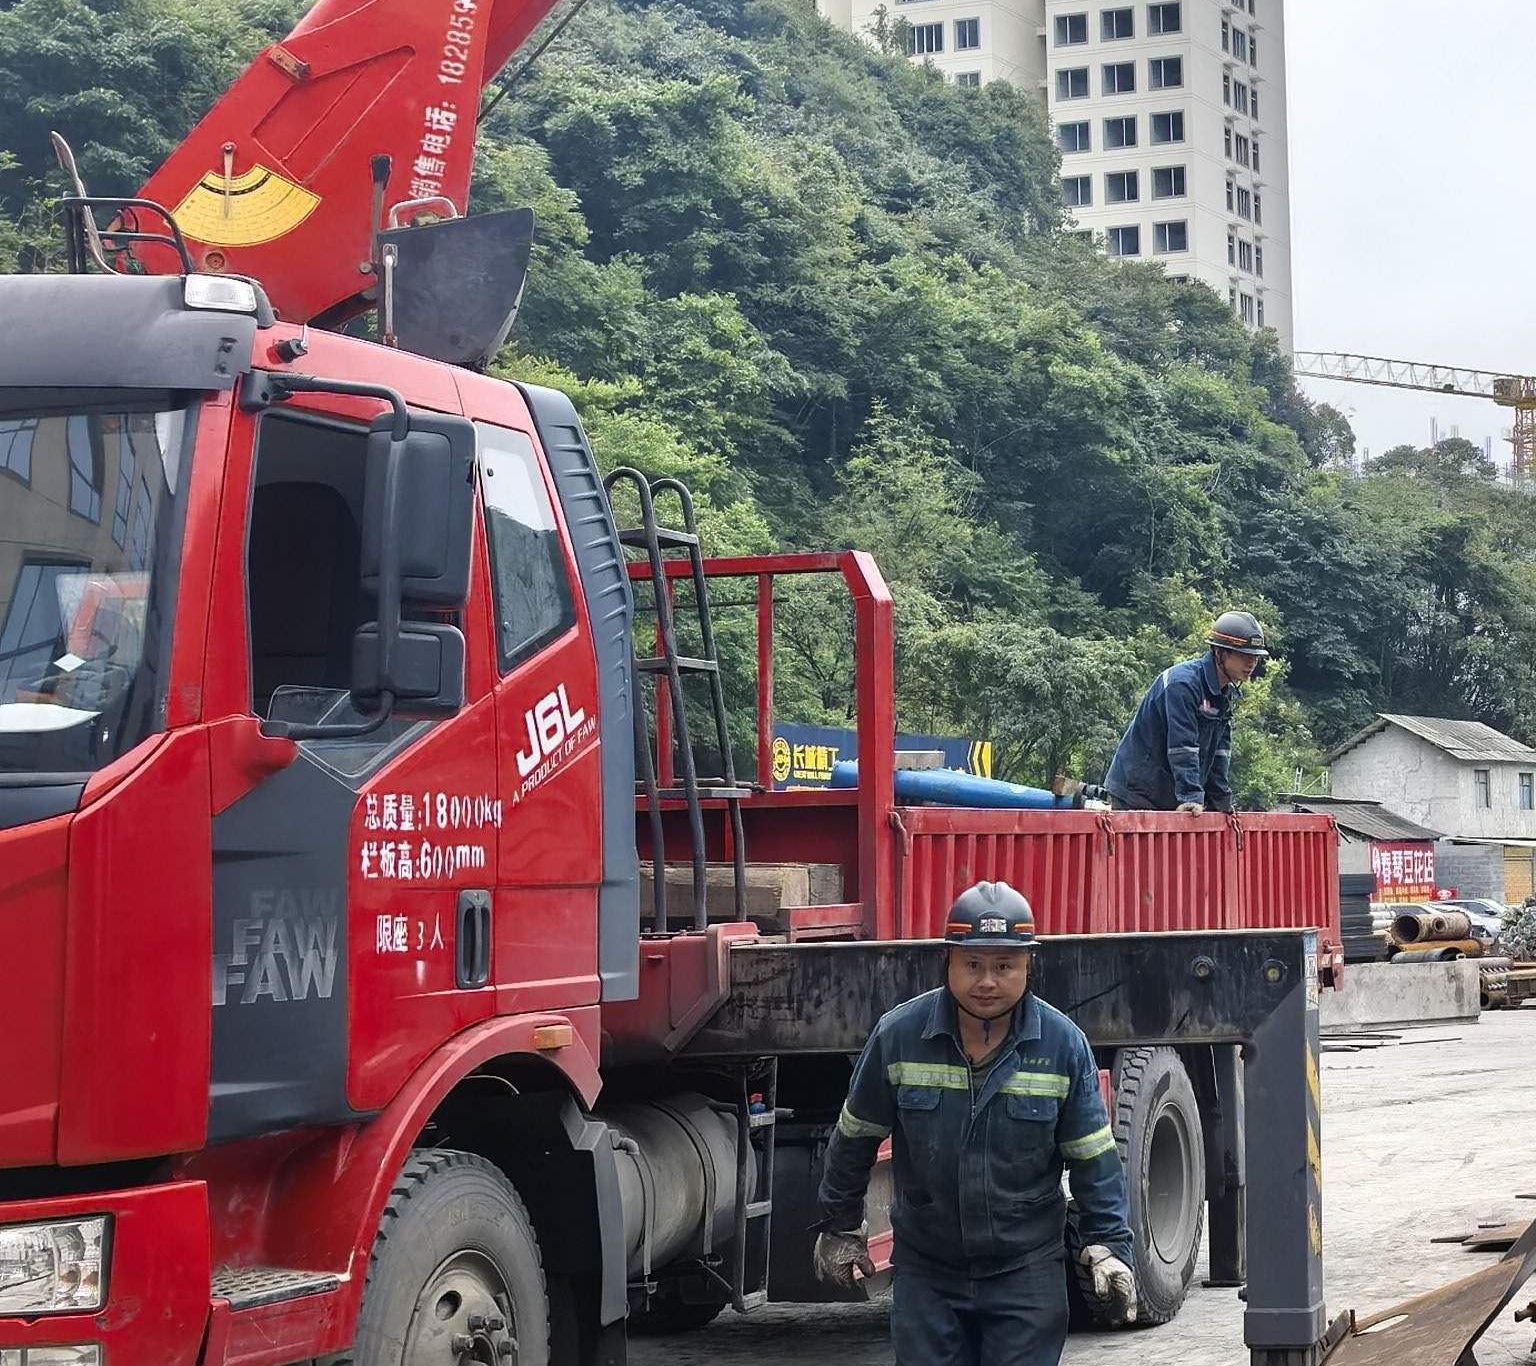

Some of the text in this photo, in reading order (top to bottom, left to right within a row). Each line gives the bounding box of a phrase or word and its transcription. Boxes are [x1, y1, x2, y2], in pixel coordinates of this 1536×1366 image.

[512, 714, 597, 808] A PRODUCT OF FAW
[516, 682, 585, 777] J6L
[211, 949, 338, 1007] FAW
